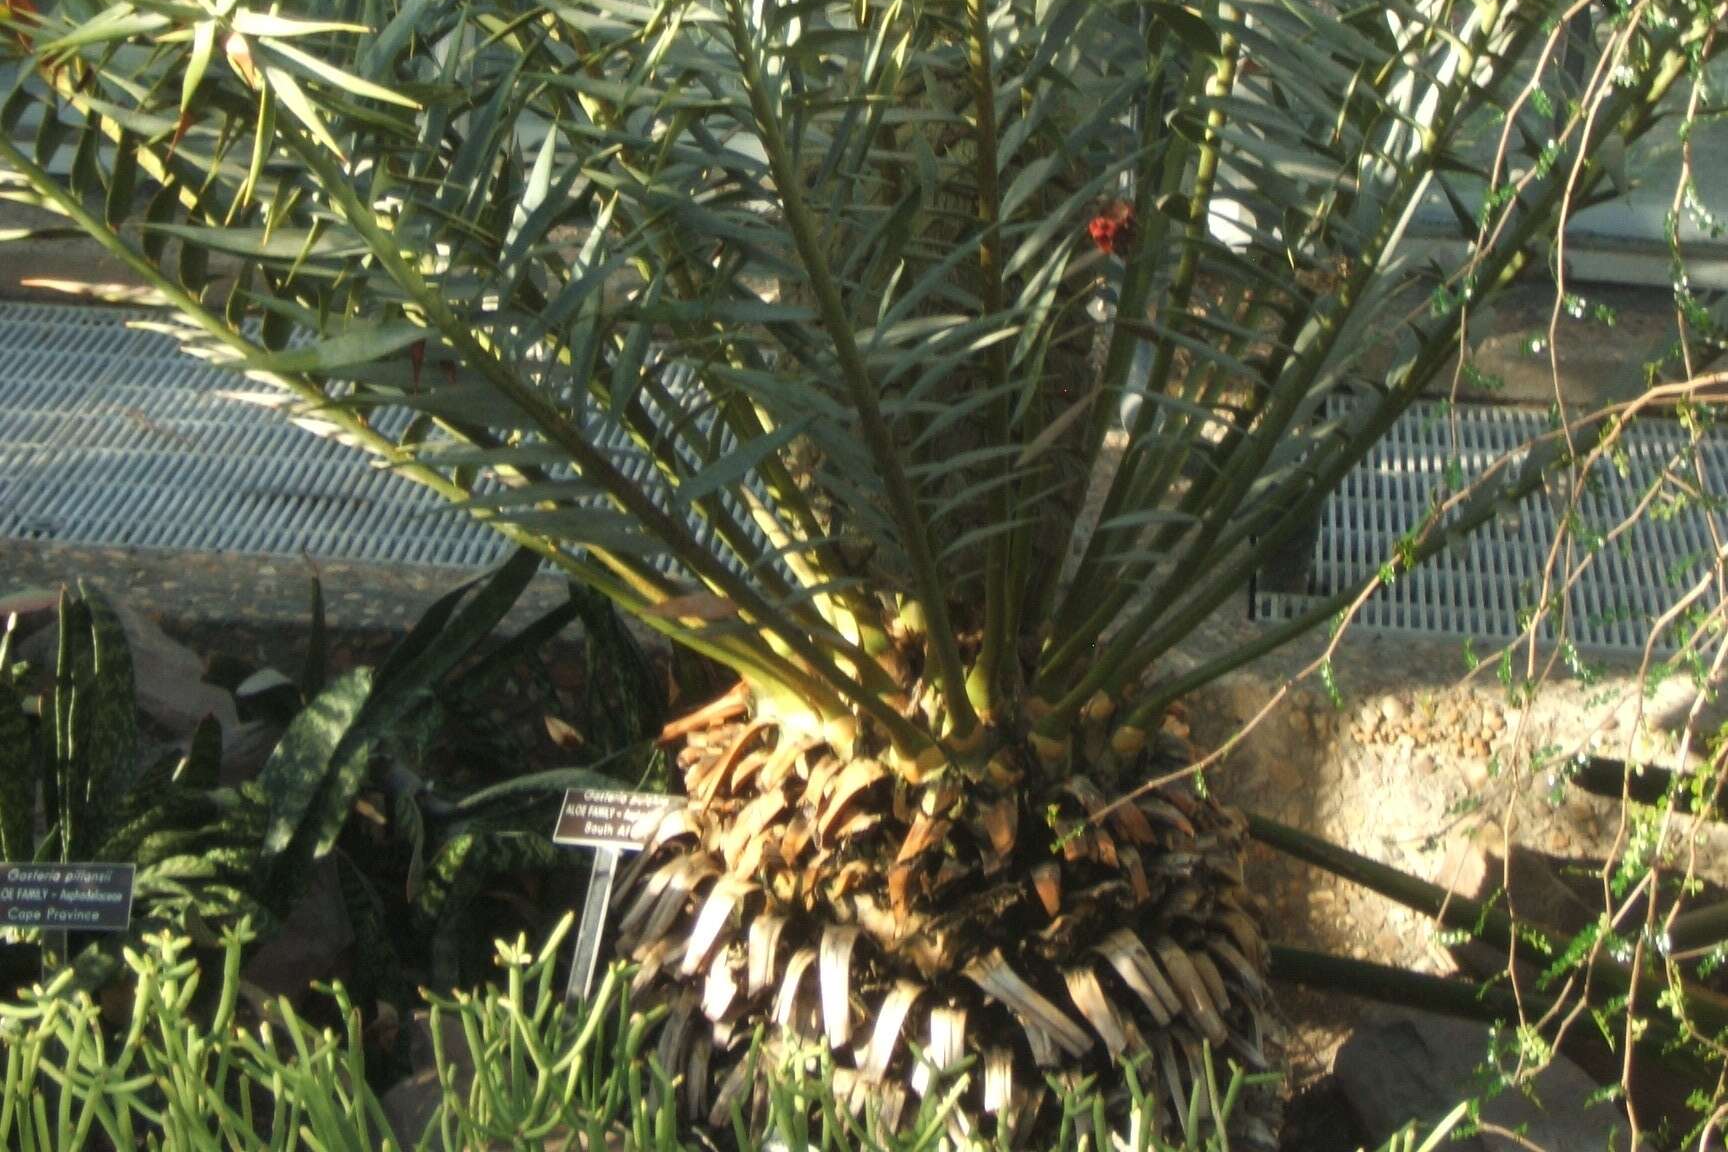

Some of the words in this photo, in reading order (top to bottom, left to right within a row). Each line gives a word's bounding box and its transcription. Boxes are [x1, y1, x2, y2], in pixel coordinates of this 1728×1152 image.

[565, 803, 586, 816] ALOE
[588, 804, 615, 819] FAMILY
[584, 821, 613, 836] South
[17, 888, 48, 901] FAMILY
[7, 906, 41, 922] Cape
[47, 907, 100, 921] Province
